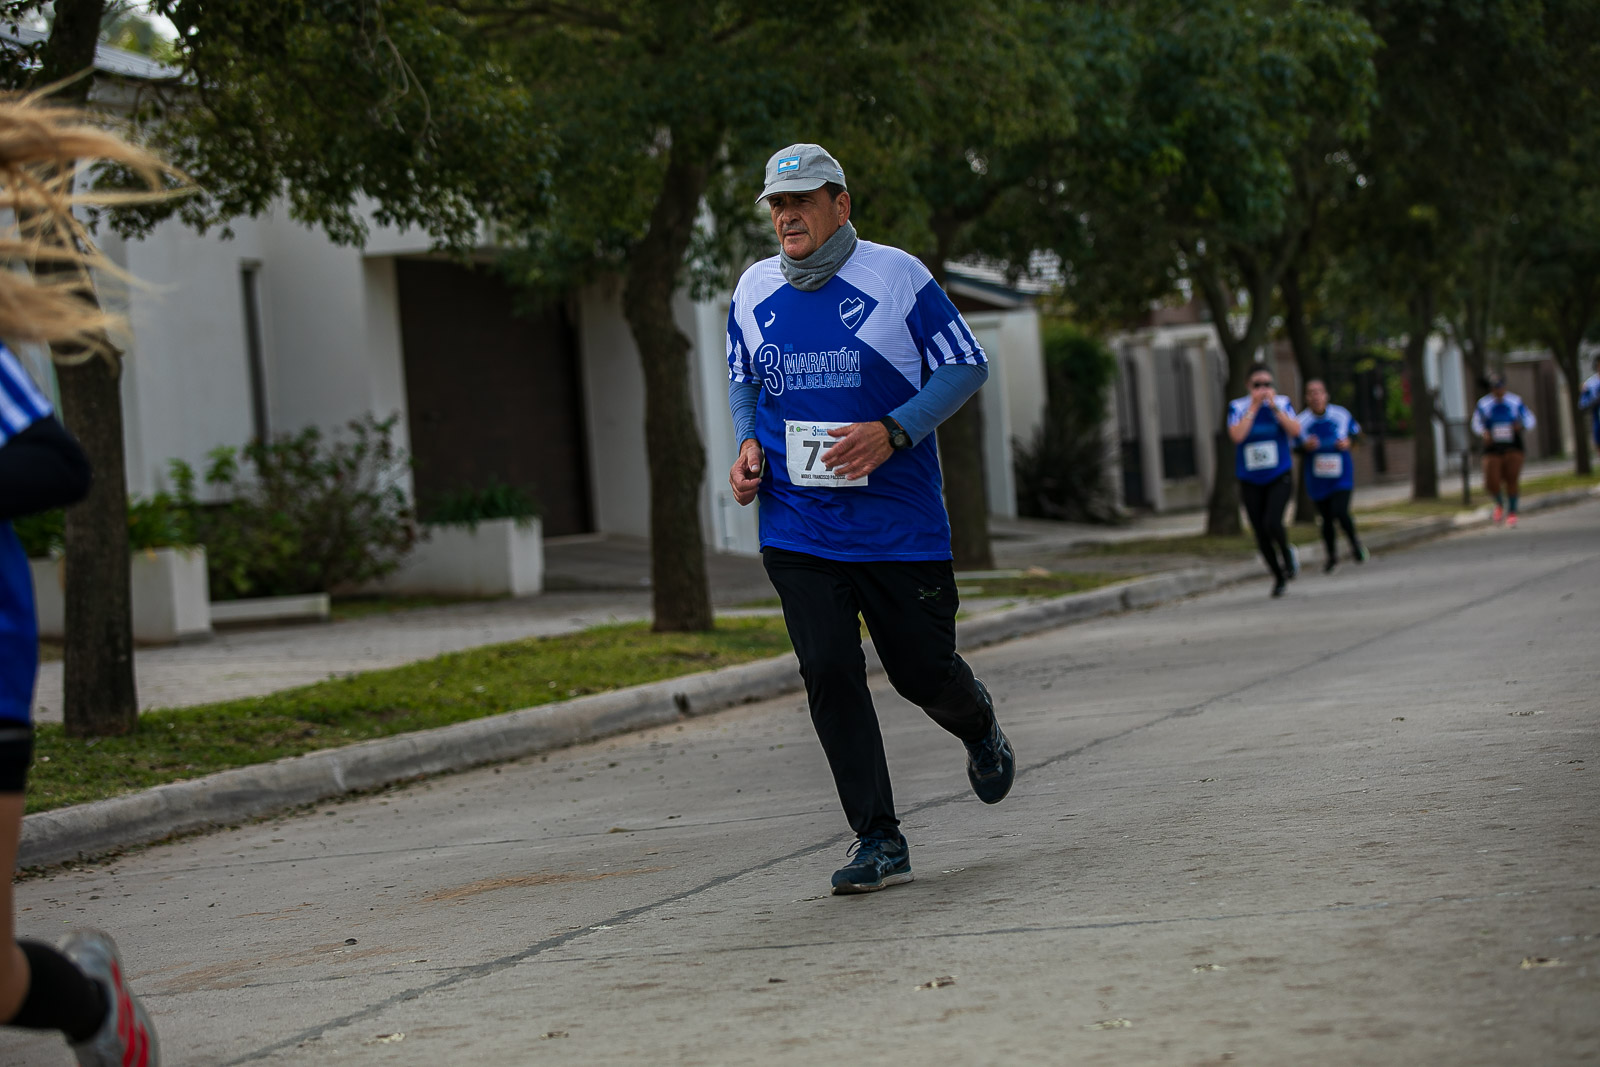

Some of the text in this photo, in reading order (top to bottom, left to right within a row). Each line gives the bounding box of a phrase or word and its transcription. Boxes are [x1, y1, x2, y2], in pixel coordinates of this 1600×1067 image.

[759, 343, 861, 396] 3 MARATÓN
[811, 425, 817, 437] 3
